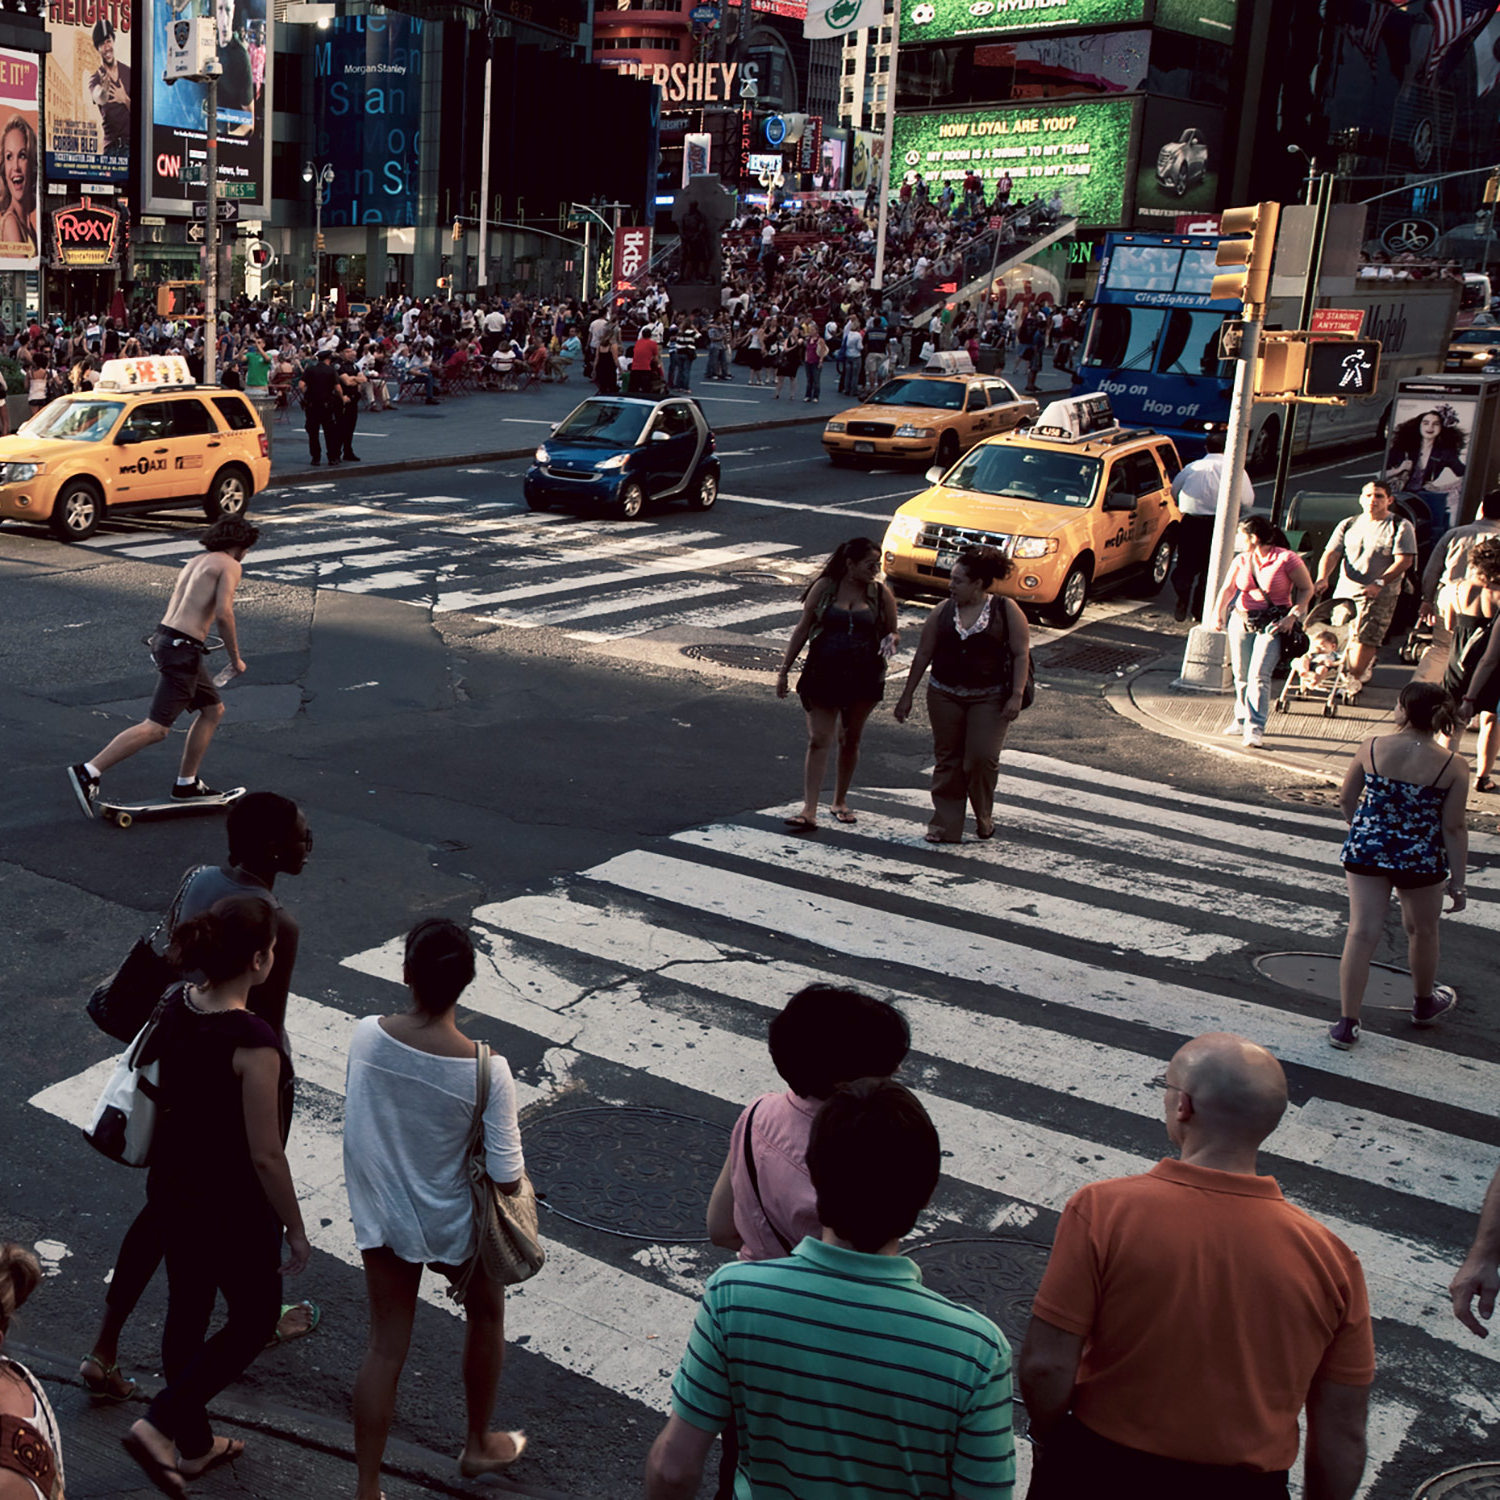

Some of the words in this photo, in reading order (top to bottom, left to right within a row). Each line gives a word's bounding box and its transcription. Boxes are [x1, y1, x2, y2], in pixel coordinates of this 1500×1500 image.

[49, 0, 132, 32] HEIGHTS
[344, 64, 376, 76] Morgan
[377, 63, 407, 75] Stanley
[618, 61, 760, 101] RSHEY'S
[939, 123, 969, 138] HOW
[971, 120, 1010, 136] LOYAL
[1012, 118, 1040, 134] ARE
[1043, 115, 1078, 132] YOU?
[53, 135, 79, 151] CORBIN
[81, 136, 98, 153] BLEU
[926, 150, 942, 162] MY
[943, 149, 971, 161] ROOM
[983, 147, 991, 159] A
[1029, 145, 1042, 156] TO
[1043, 144, 1059, 156] MY
[1061, 142, 1090, 155] TEAM
[156, 153, 181, 178] CNN
[941, 168, 969, 181] HOUS
[1030, 165, 1043, 177] TO
[1044, 164, 1060, 176] MY
[1062, 163, 1091, 175] TEAM
[225, 184, 245, 197] TIMES
[58, 213, 113, 241] ROXY
[622, 230, 644, 278] tkts
[1134, 292, 1195, 306] CitySights
[1196, 295, 1212, 306] NY
[1314, 311, 1326, 320] NO
[1327, 312, 1360, 321] STANDING
[1316, 321, 1352, 330] ANYTIME
[1097, 379, 1127, 395] Hop
[1129, 384, 1148, 395] on
[1142, 399, 1173, 415] Hop
[1176, 403, 1200, 416] off
[119, 465, 138, 475] NYC
[137, 457, 167, 475] TAXI
